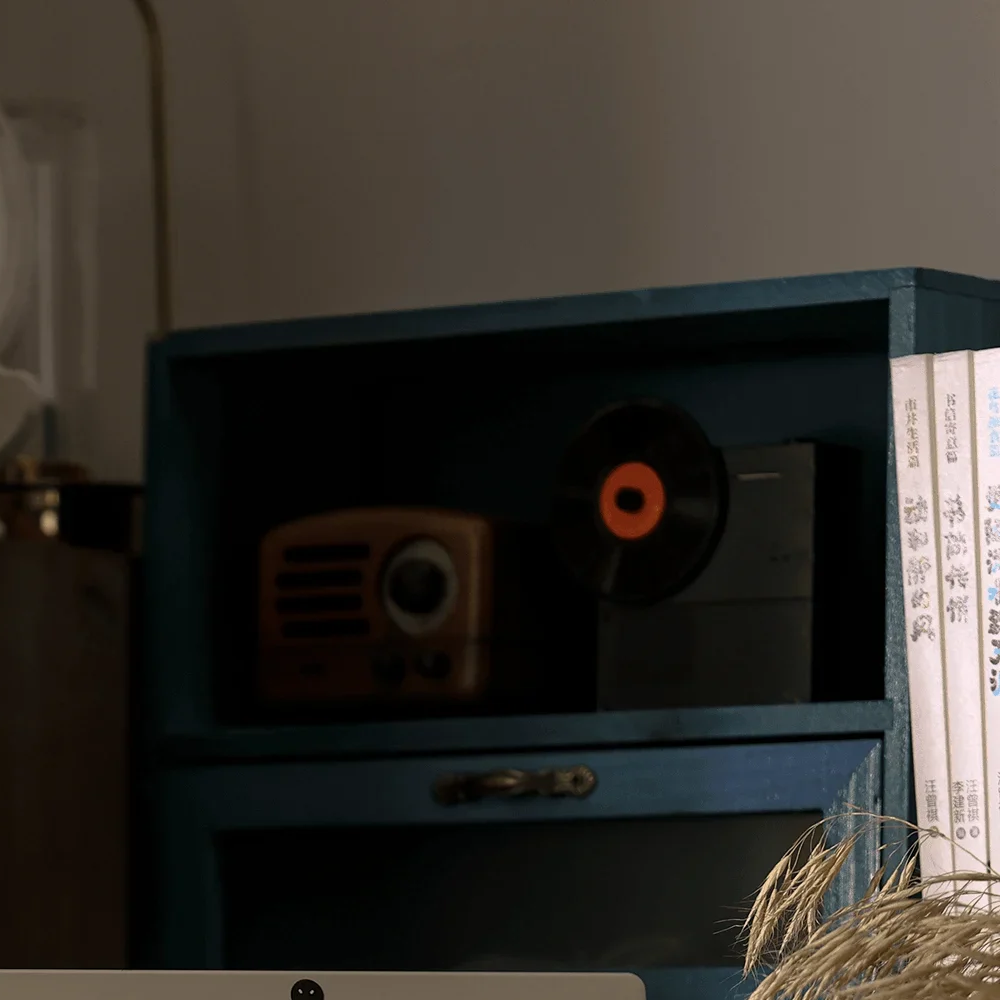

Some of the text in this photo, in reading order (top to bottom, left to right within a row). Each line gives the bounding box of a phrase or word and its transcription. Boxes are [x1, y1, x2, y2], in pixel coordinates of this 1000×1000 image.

[925, 779, 939, 822] 汪曾祺
[952, 781, 965, 824] 李建新
[966, 779, 979, 822] 汪曾祺
